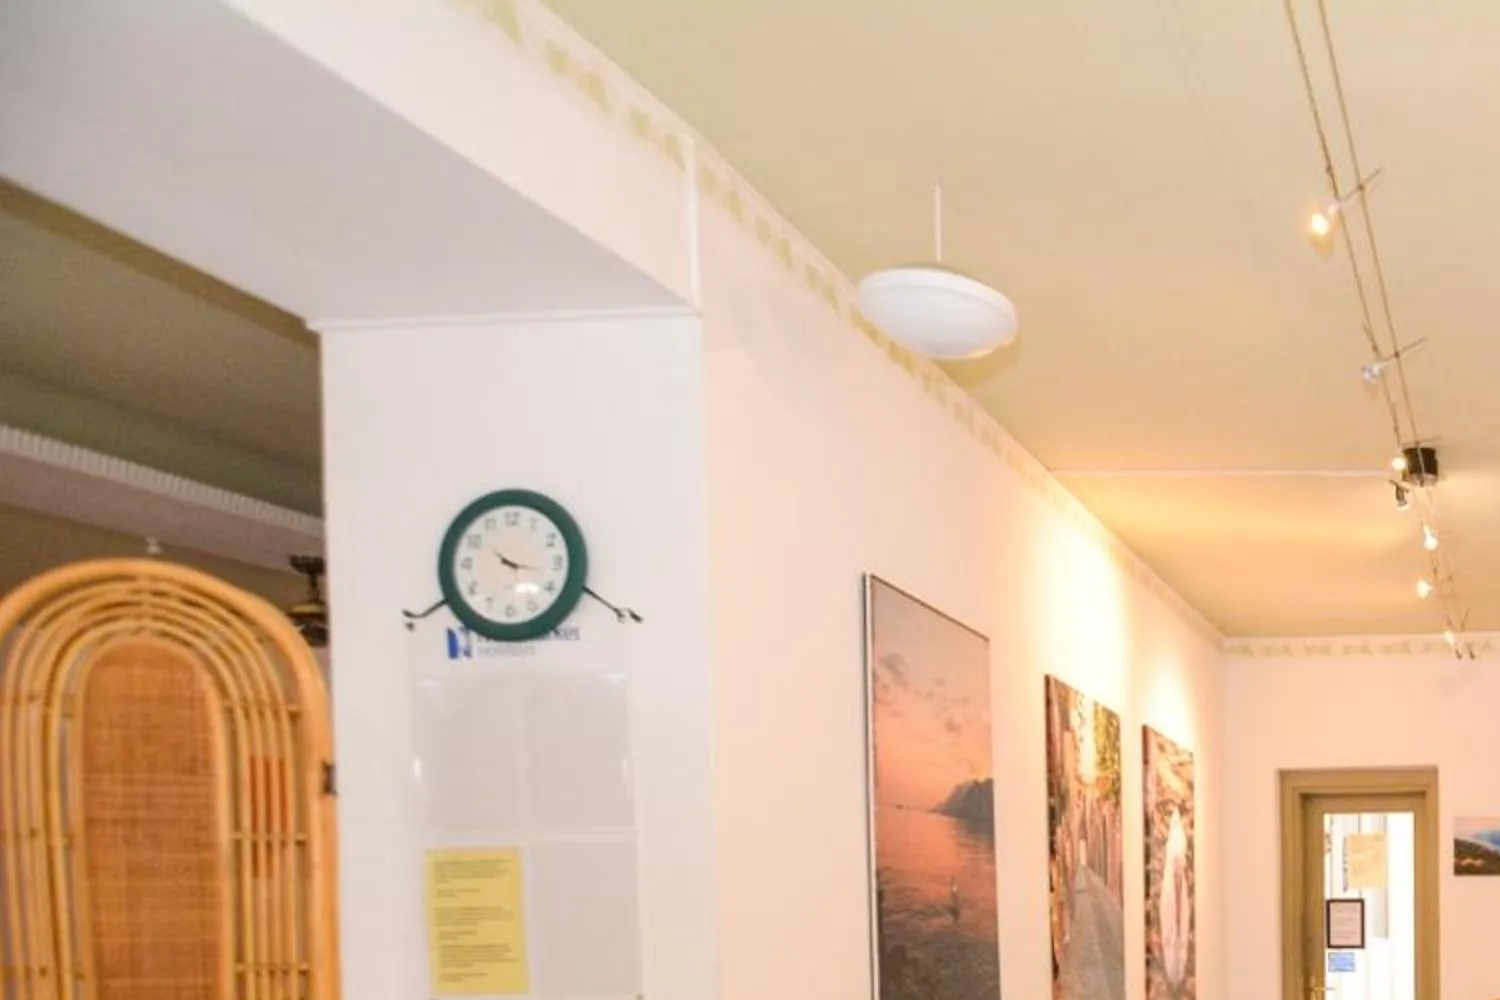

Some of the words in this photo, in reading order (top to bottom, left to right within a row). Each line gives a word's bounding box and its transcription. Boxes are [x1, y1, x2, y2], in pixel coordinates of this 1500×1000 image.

[504, 511, 521, 527] 12
[545, 532, 557, 548] 2
[552, 554, 564, 571] 3
[544, 580, 556, 595] 4
[504, 604, 516, 618] 6
